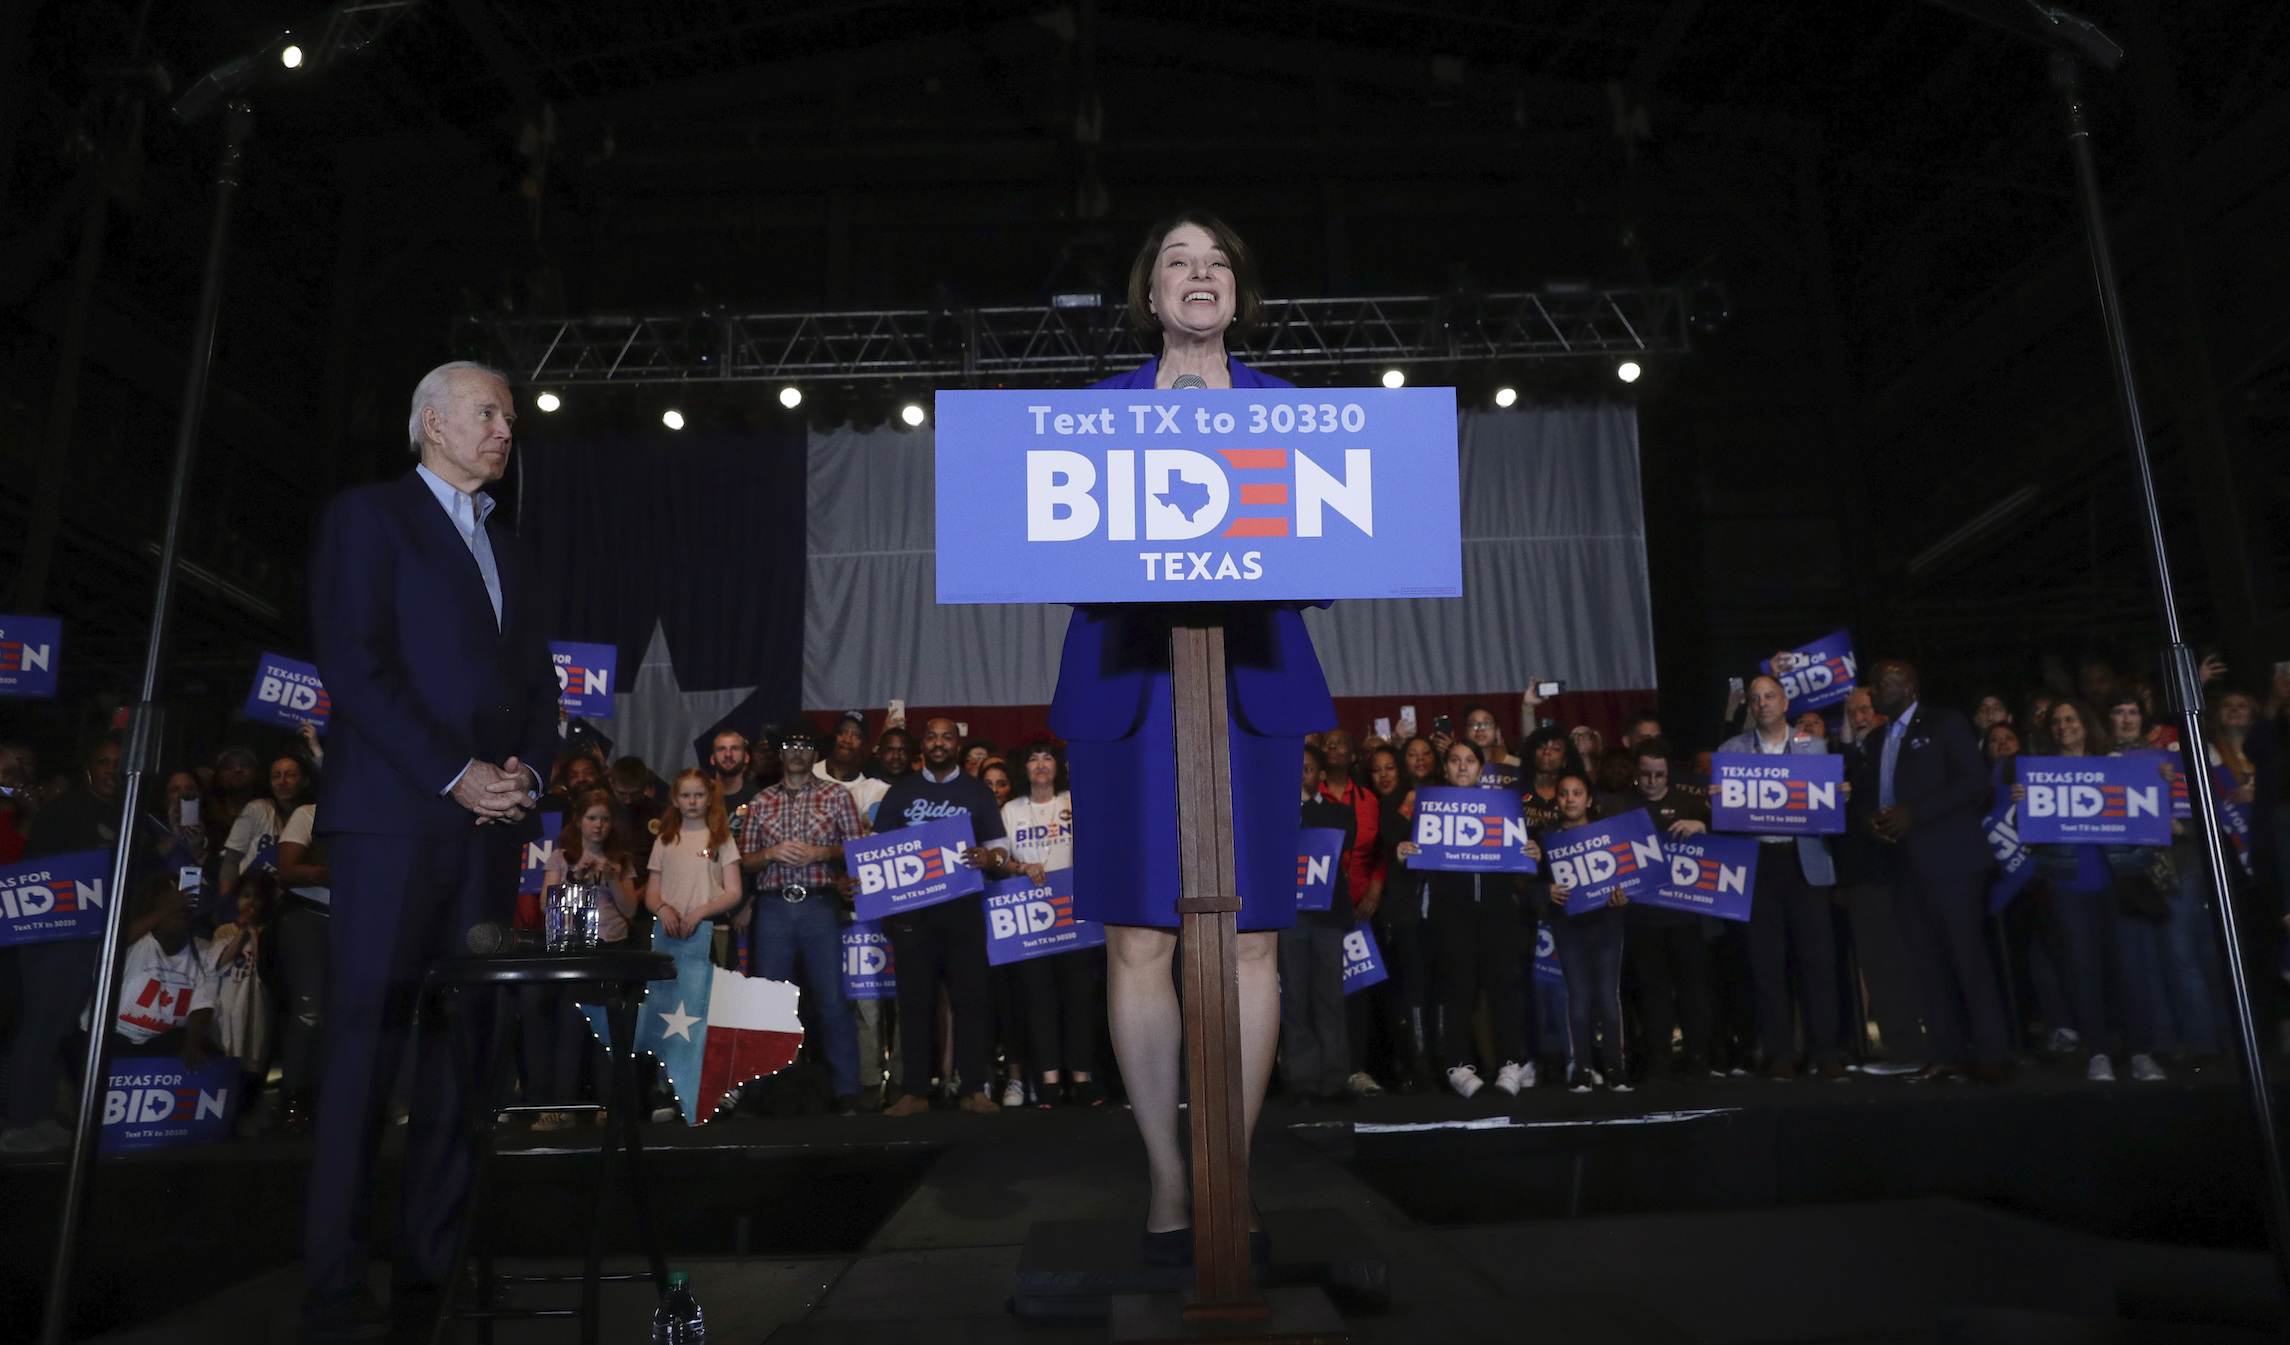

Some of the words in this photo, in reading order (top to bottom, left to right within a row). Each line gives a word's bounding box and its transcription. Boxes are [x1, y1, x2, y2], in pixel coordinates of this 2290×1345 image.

[1028, 405, 1116, 435] Text
[1128, 404, 1182, 434] TX
[1195, 407, 1236, 435] to
[1249, 403, 1366, 434] 30330
[1026, 448, 1373, 541] BIDEN
[1139, 551, 1263, 581] TEXAS
[552, 653, 572, 665] FOR
[267, 665, 302, 682] TEXAS
[554, 664, 608, 696] DEN
[1780, 651, 1858, 700] BIDEN
[258, 675, 332, 716] BIDE
[1721, 766, 1762, 778] TEXAS
[1764, 767, 1790, 779] FOR
[2026, 771, 2074, 784] TEXAS
[2075, 772, 2105, 784] FOR
[1721, 778, 1836, 811] BIDEN
[2027, 785, 2160, 819] BIDEN
[1421, 801, 1460, 813] TEXAS
[1461, 802, 1487, 814] FOR
[1016, 823, 1072, 842] BIDEN
[1417, 813, 1528, 847] BIDEN
[855, 846, 896, 863] TEXAS
[896, 839, 922, 855] FOR
[1445, 852, 1460, 860] Text
[1547, 842, 1585, 860] TEXAS
[1585, 834, 1611, 850] FOR
[1679, 843, 1706, 857] FOR
[857, 840, 970, 895] BIDEN
[1550, 834, 1664, 892] BIDEN
[19, 871, 52, 885] FOR
[0, 878, 104, 919] IDEN
[891, 894, 907, 902] Text
[907, 890, 917, 899] TX
[987, 891, 1028, 908] TEXAS
[1028, 886, 1053, 900] FOR
[13, 924, 32, 932] Text
[32, 921, 44, 930] TX
[989, 895, 1085, 940] BIDE
[1022, 940, 1038, 948] Text
[1038, 937, 1048, 946] TX
[1343, 960, 1376, 980] TEXA
[108, 1074, 152, 1087] TEXAS
[153, 1074, 183, 1086] FOR
[102, 1088, 228, 1125] BIDEN
[125, 1130, 141, 1138] Text
[142, 1130, 154, 1138] TX
